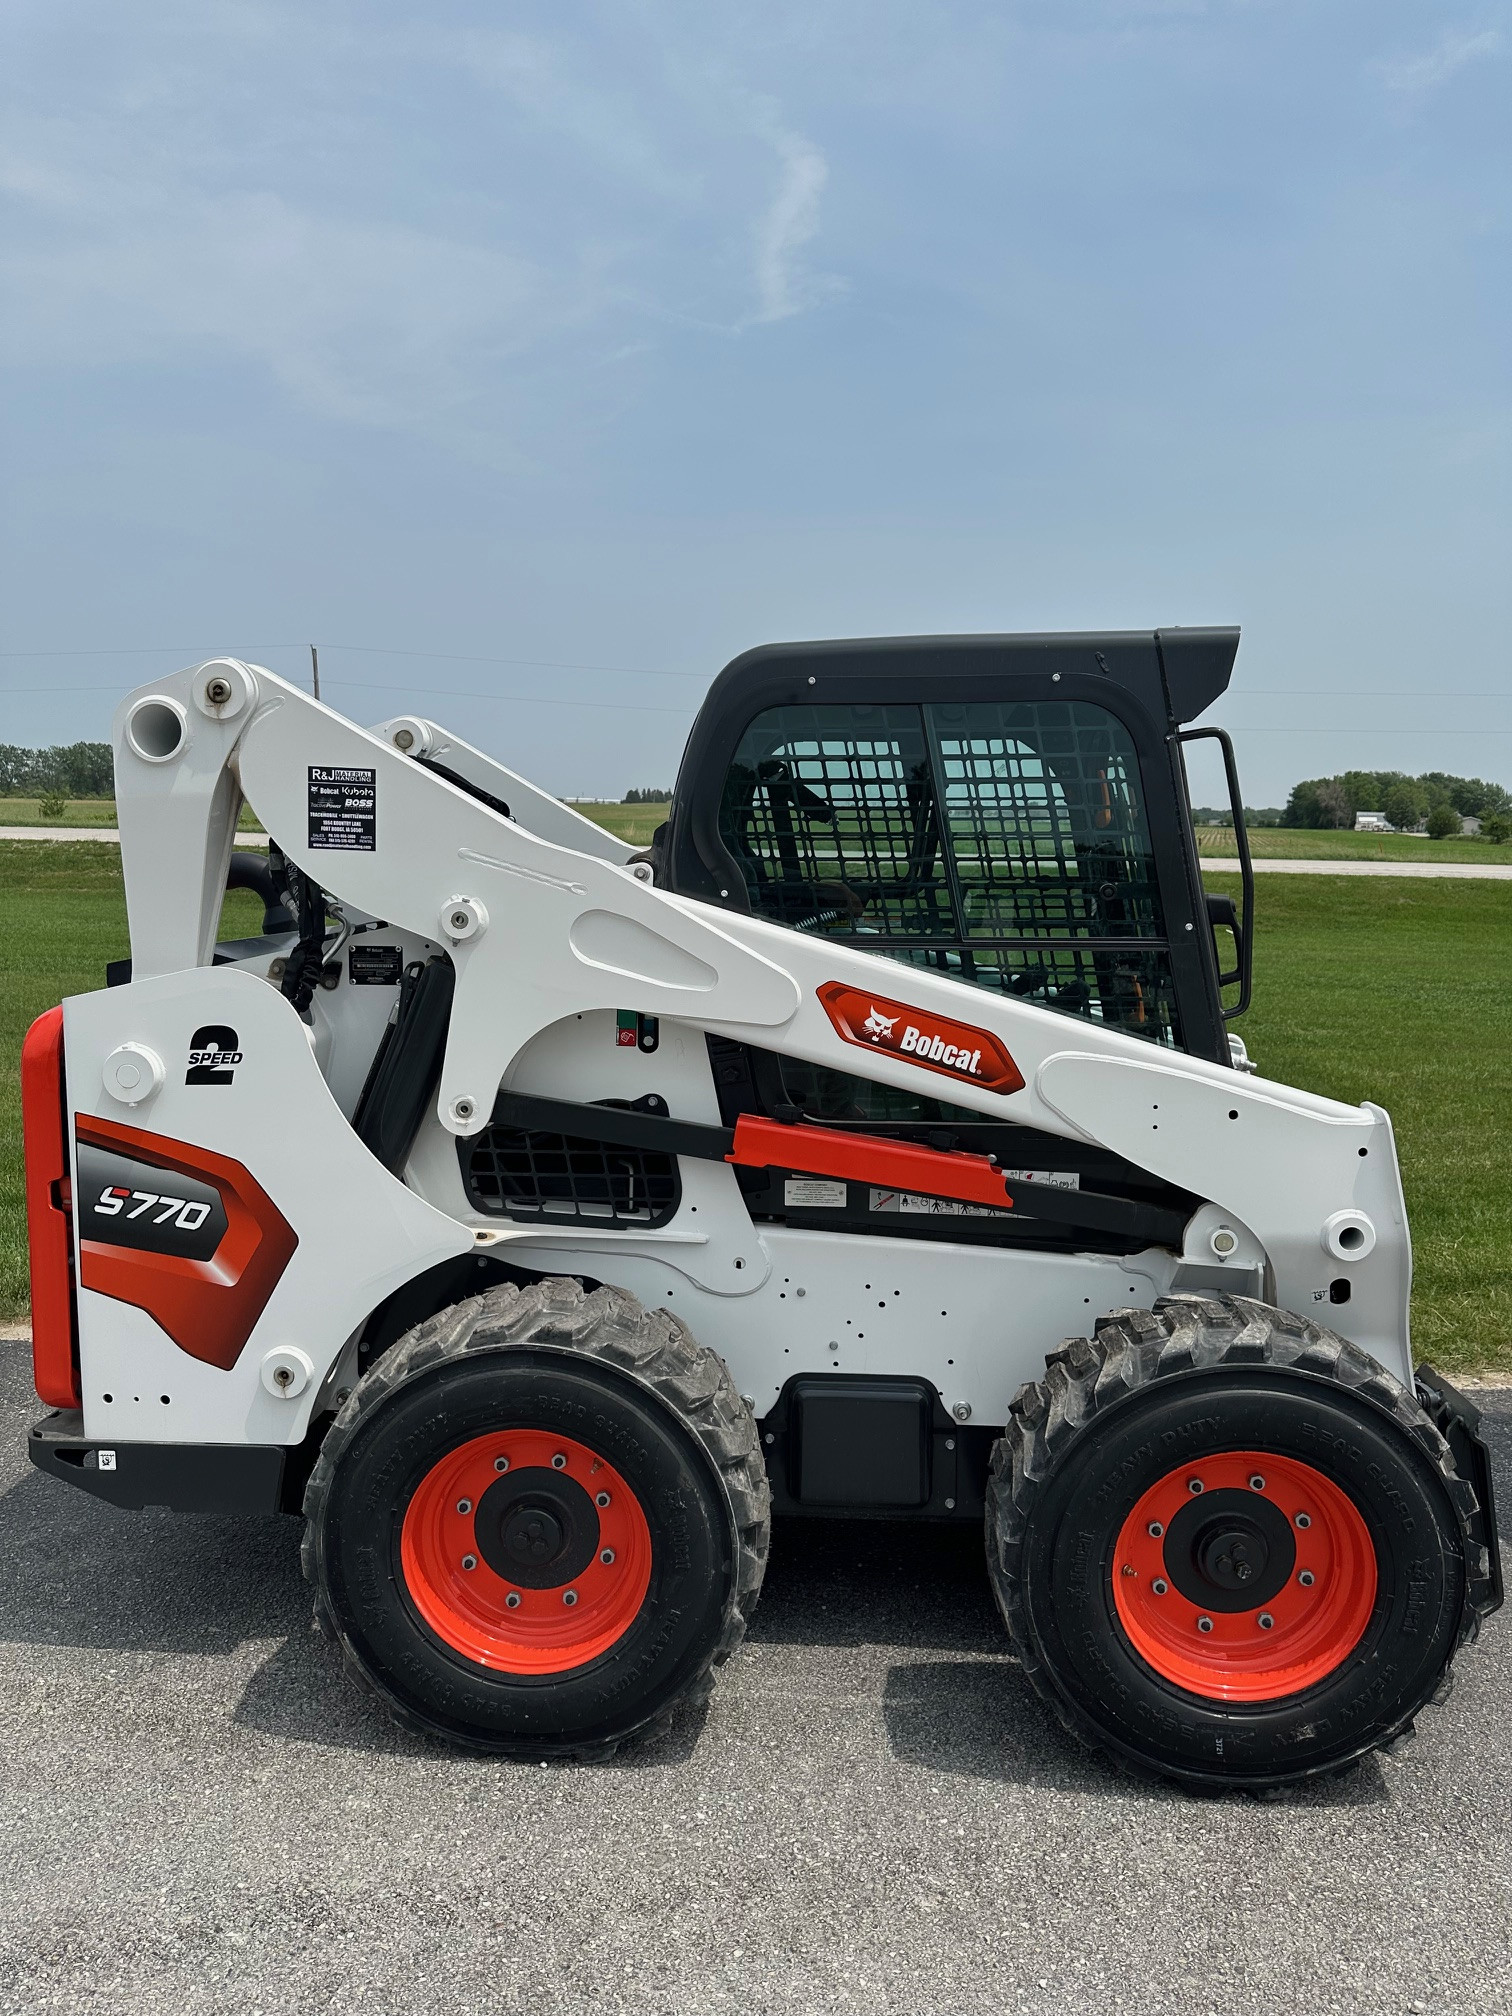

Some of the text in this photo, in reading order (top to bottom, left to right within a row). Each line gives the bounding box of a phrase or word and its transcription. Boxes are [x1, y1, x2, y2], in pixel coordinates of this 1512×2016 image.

[312, 768, 335, 781] R&J
[320, 787, 340, 795] Bobcat
[341, 786, 374, 796] Kubota
[344, 798, 374, 807] BOSS
[185, 1025, 239, 1085] 2
[188, 1052, 243, 1065] SPEED
[900, 1025, 982, 1074] Bobcat
[93, 1186, 212, 1231] S770
[1097, 1446, 1155, 1504] HEAVY
[1160, 1415, 1224, 1447] DUTY
[1365, 1462, 1416, 1533] GUARD
